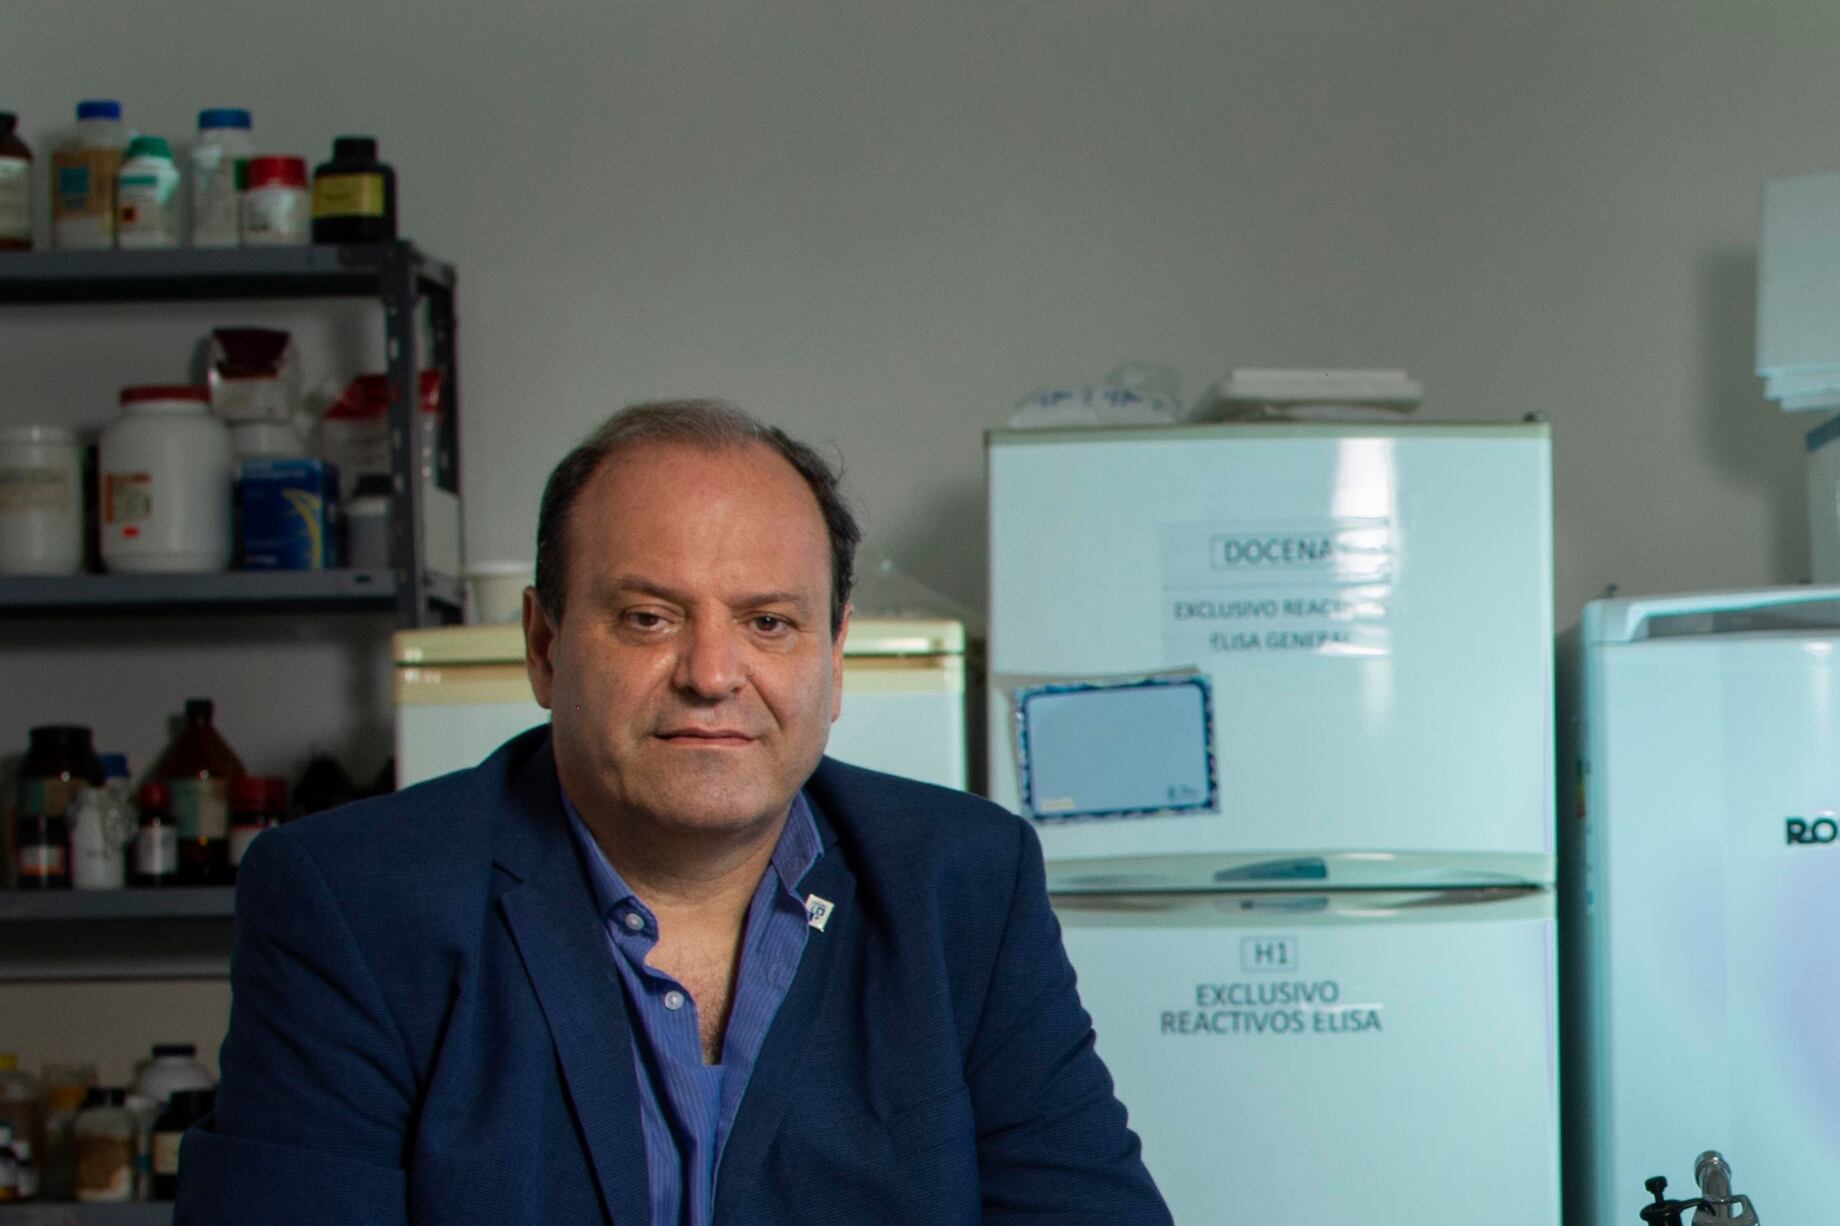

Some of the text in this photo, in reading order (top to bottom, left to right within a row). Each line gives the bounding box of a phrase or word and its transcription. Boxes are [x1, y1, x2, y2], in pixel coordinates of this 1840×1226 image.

[1223, 537, 1335, 565] DOCENA
[1173, 600, 1279, 621] EXCLUSIVO
[1209, 631, 1261, 651] ELISA
[1254, 942, 1288, 965] H1
[1195, 979, 1340, 1007] EXCLUSIVO
[1160, 1008, 1382, 1034] REACTIVOS ELISA
